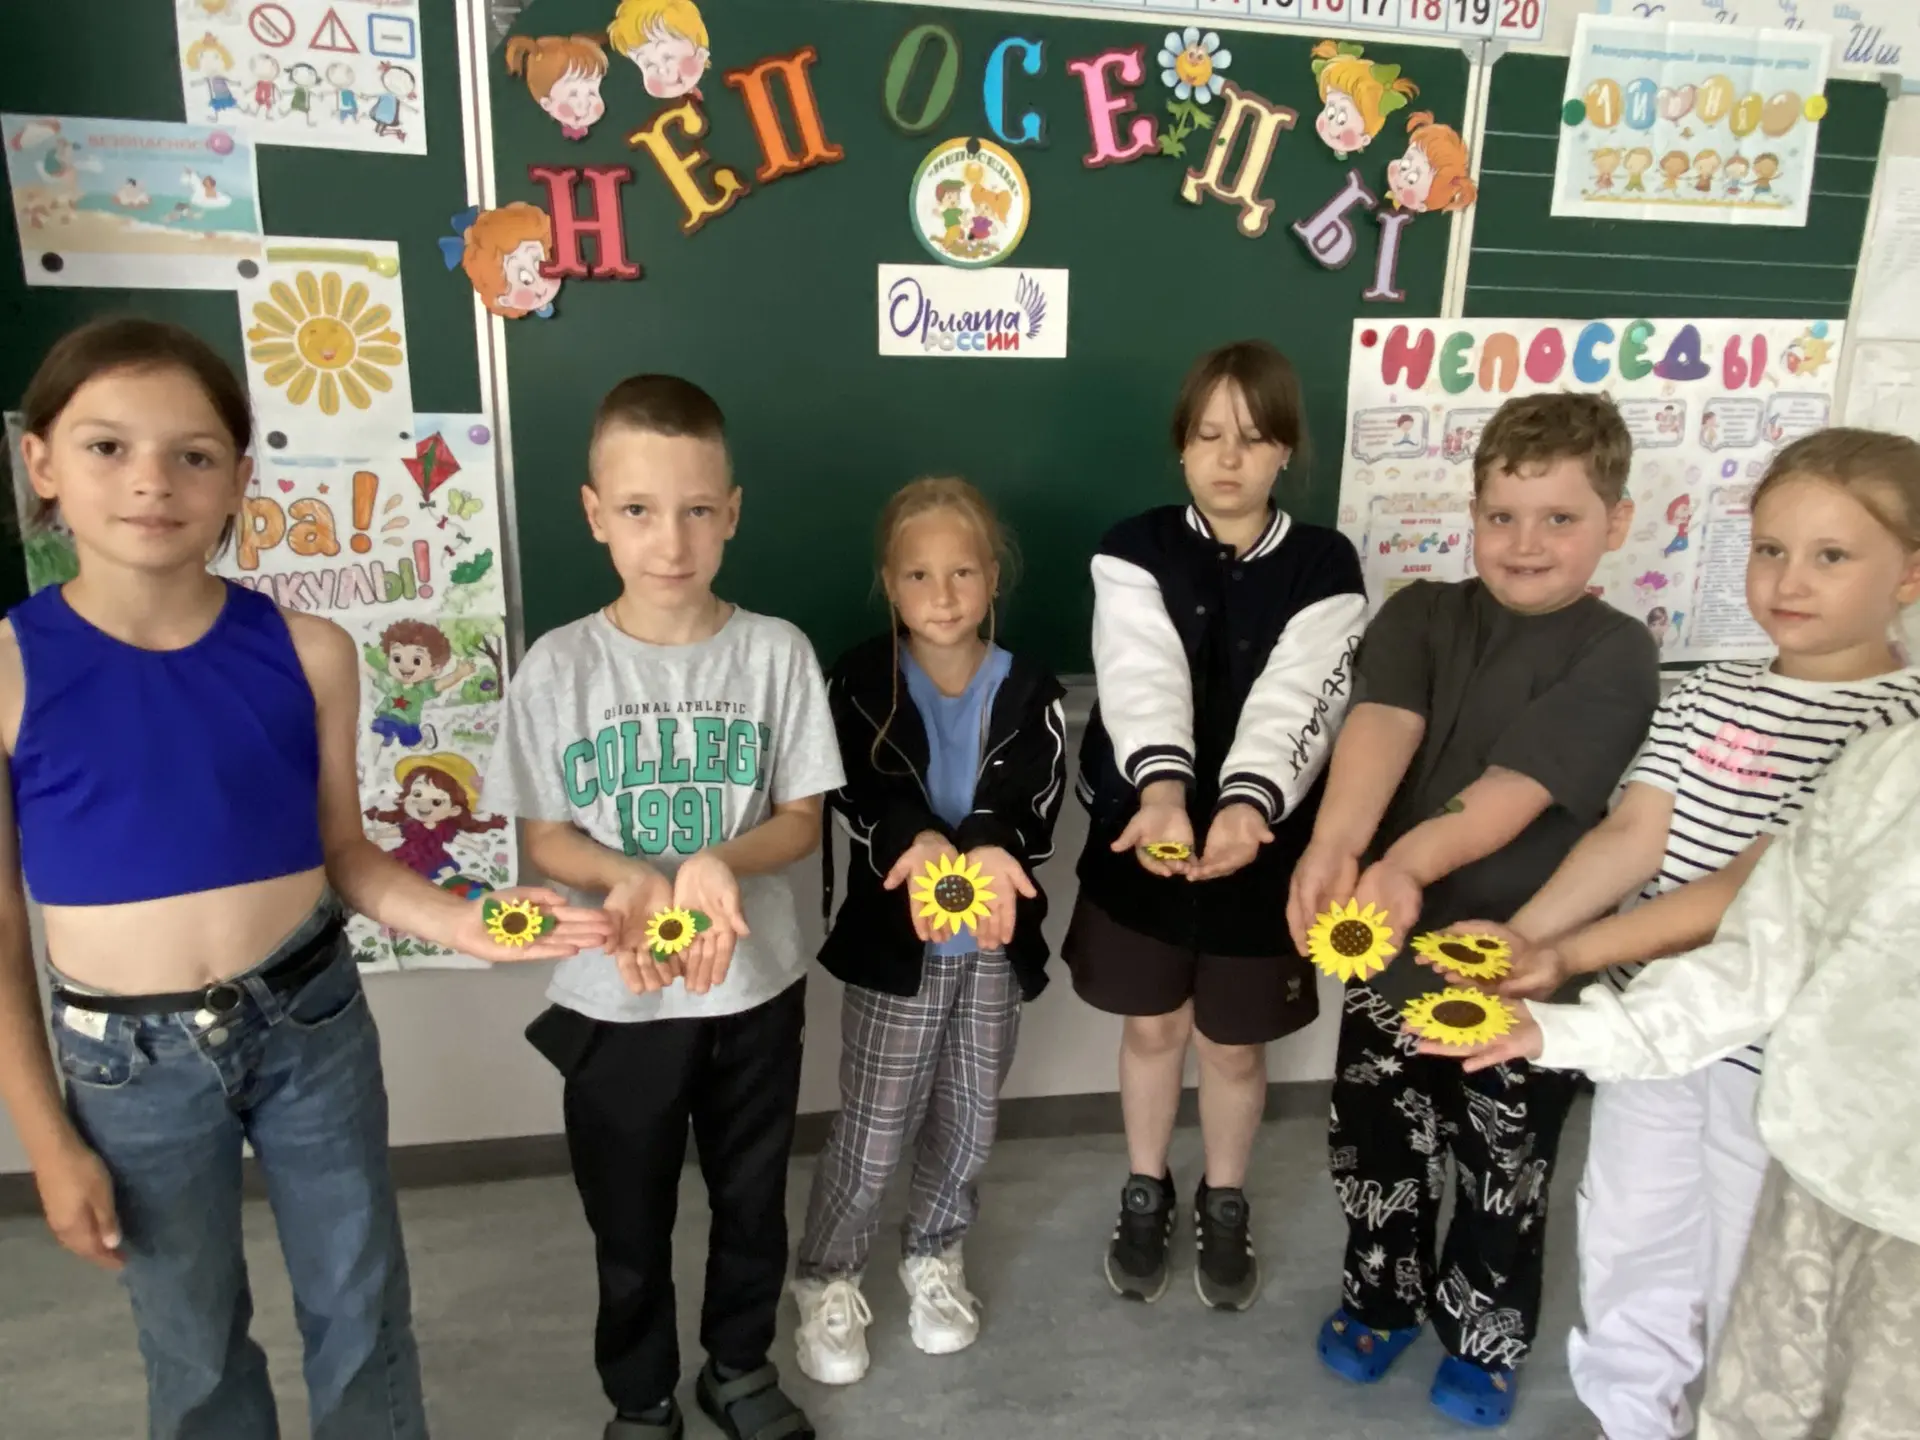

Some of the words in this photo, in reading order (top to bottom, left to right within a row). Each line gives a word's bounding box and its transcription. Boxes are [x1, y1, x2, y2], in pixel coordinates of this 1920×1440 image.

[1458, 0, 1490, 25] 19
[1500, 0, 1540, 29] 20
[888, 277, 1021, 344] Орлята
[924, 331, 1020, 352] РОССИИ
[1381, 320, 1767, 394] НЕПОСЕДЫ
[235, 470, 380, 571] ра!
[676, 700, 747, 715] ATHLETIC
[1286, 697, 1330, 780] player
[616, 786, 726, 857] 1991
